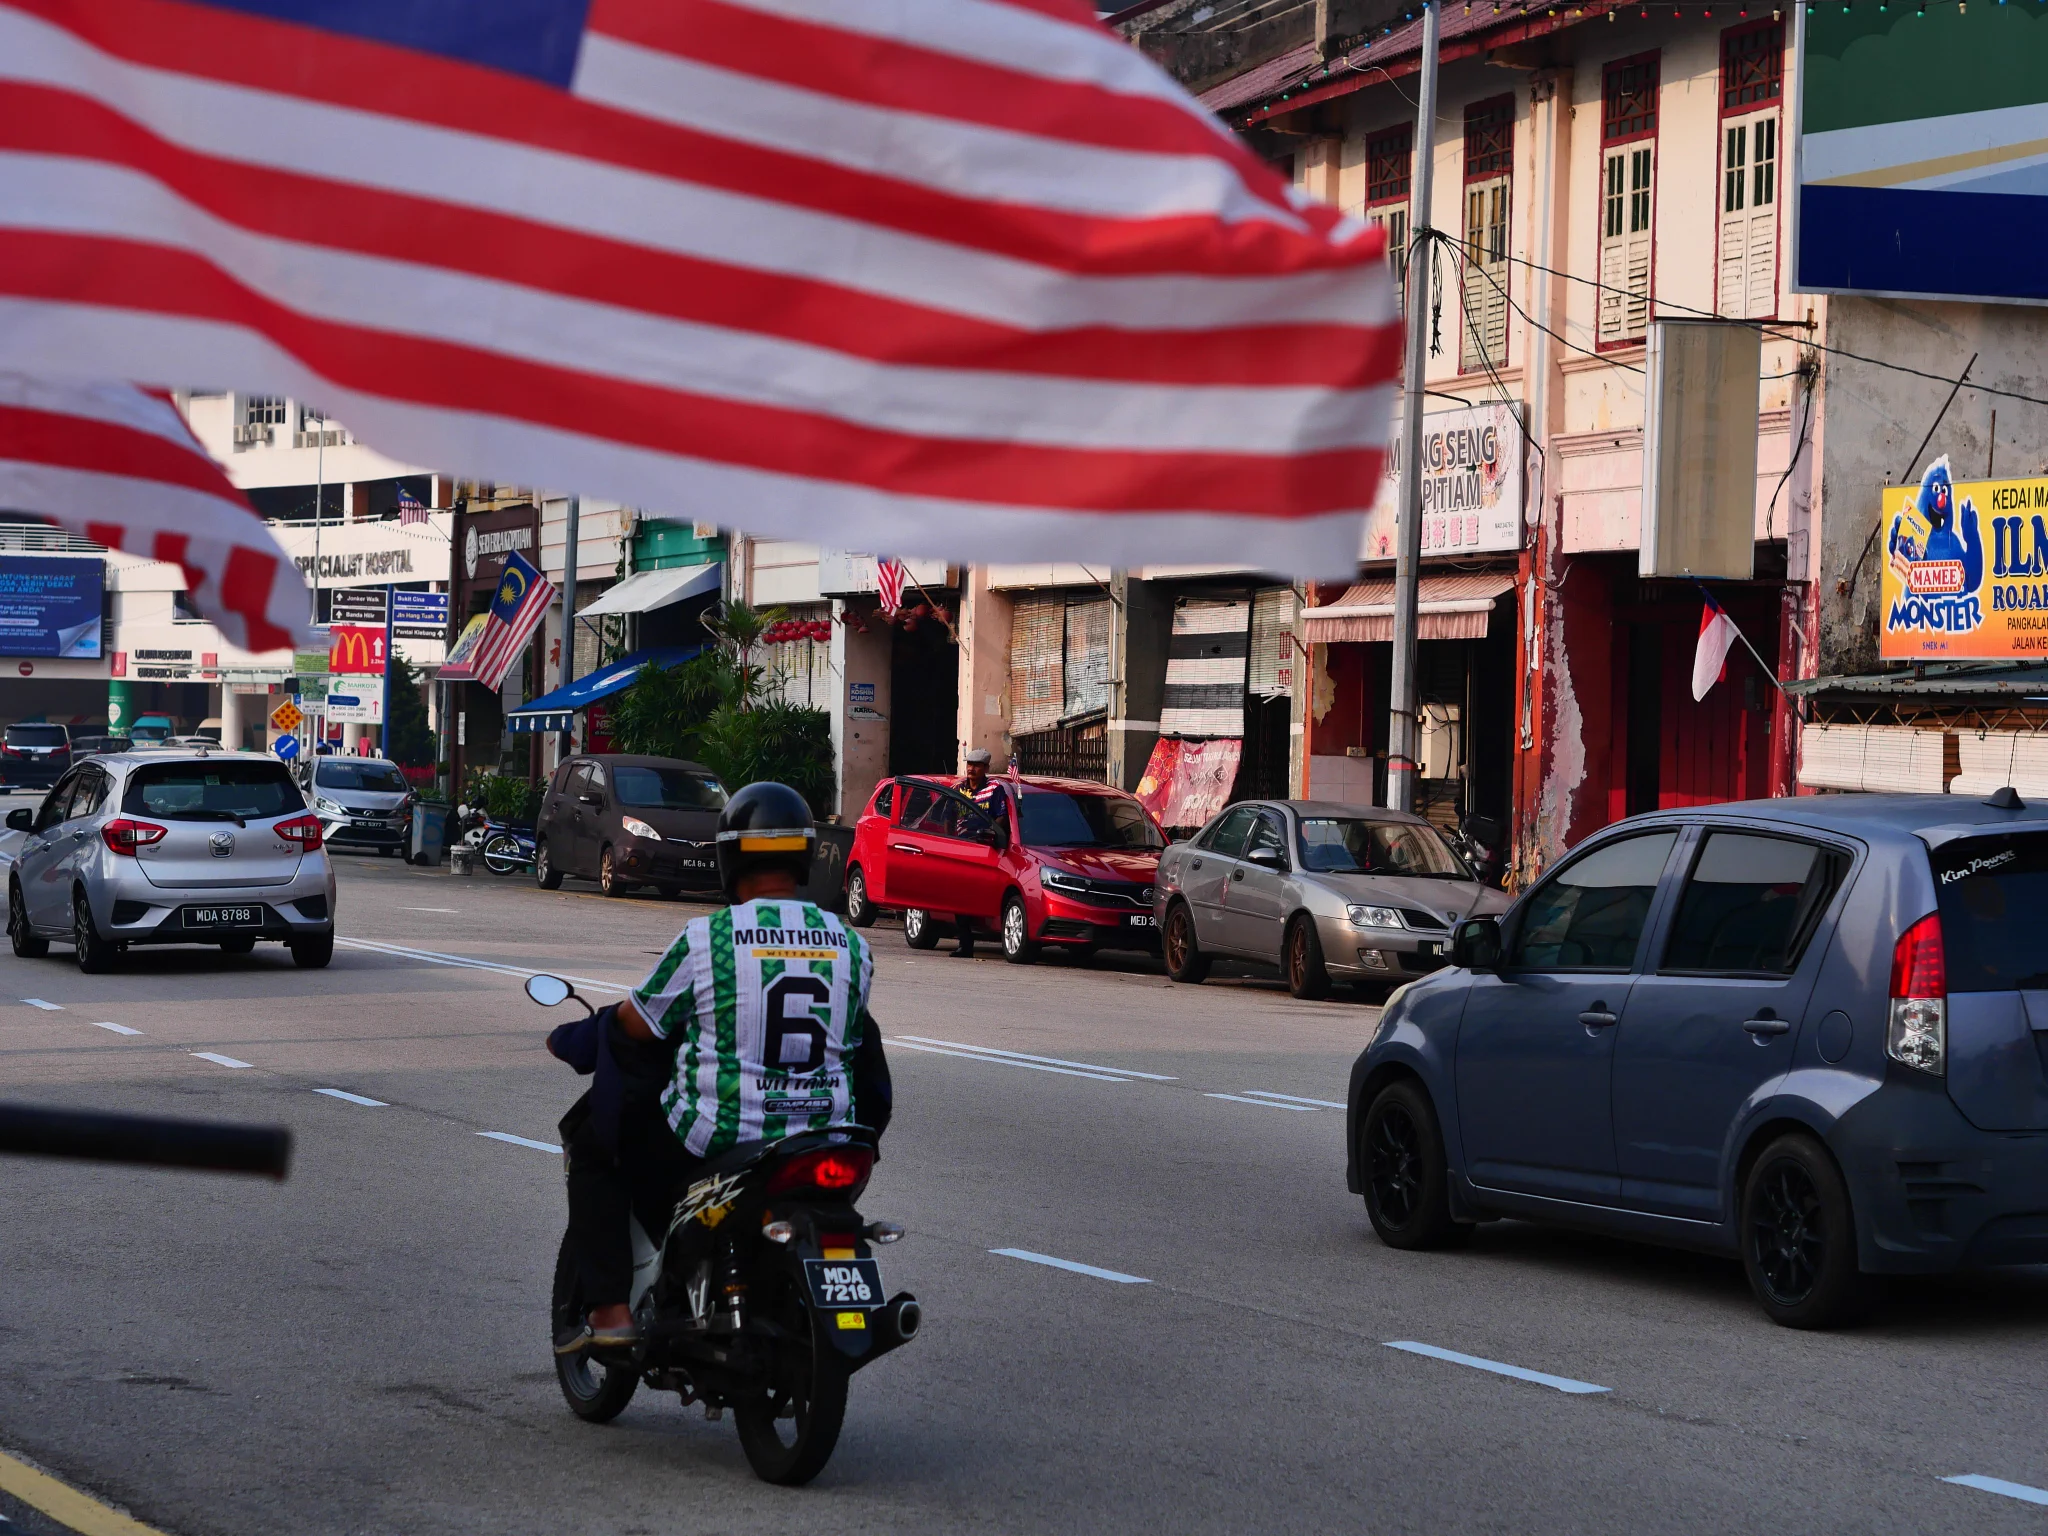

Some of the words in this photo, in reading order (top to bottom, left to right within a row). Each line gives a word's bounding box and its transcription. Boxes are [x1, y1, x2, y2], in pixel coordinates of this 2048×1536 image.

[1386, 432, 1443, 473] MNG
[1446, 426, 1497, 469] SENG
[1992, 487, 2031, 511] KEDAI
[365, 549, 414, 576] HOSPITAL
[1913, 569, 1957, 586] MAMEE
[1888, 595, 1983, 632] MONSTER
[414, 629, 436, 637] Klebang
[1922, 641, 1939, 650] SNEK
[2012, 636, 2036, 650] JALAN
[683, 859, 696, 868] MCA
[1941, 870, 1970, 885] Kim
[1968, 850, 2015, 873] Power
[196, 909, 218, 922] MDA
[221, 908, 251, 921] 8788
[1130, 915, 1147, 926] MED
[734, 928, 848, 949] MONTHONG
[766, 950, 826, 958] WITTAYA
[762, 975, 830, 1075] 6
[755, 1076, 840, 1091] WITTAYA
[768, 1099, 830, 1109] COMPASS
[823, 1266, 865, 1285] MDA
[820, 1283, 872, 1302] 7218
